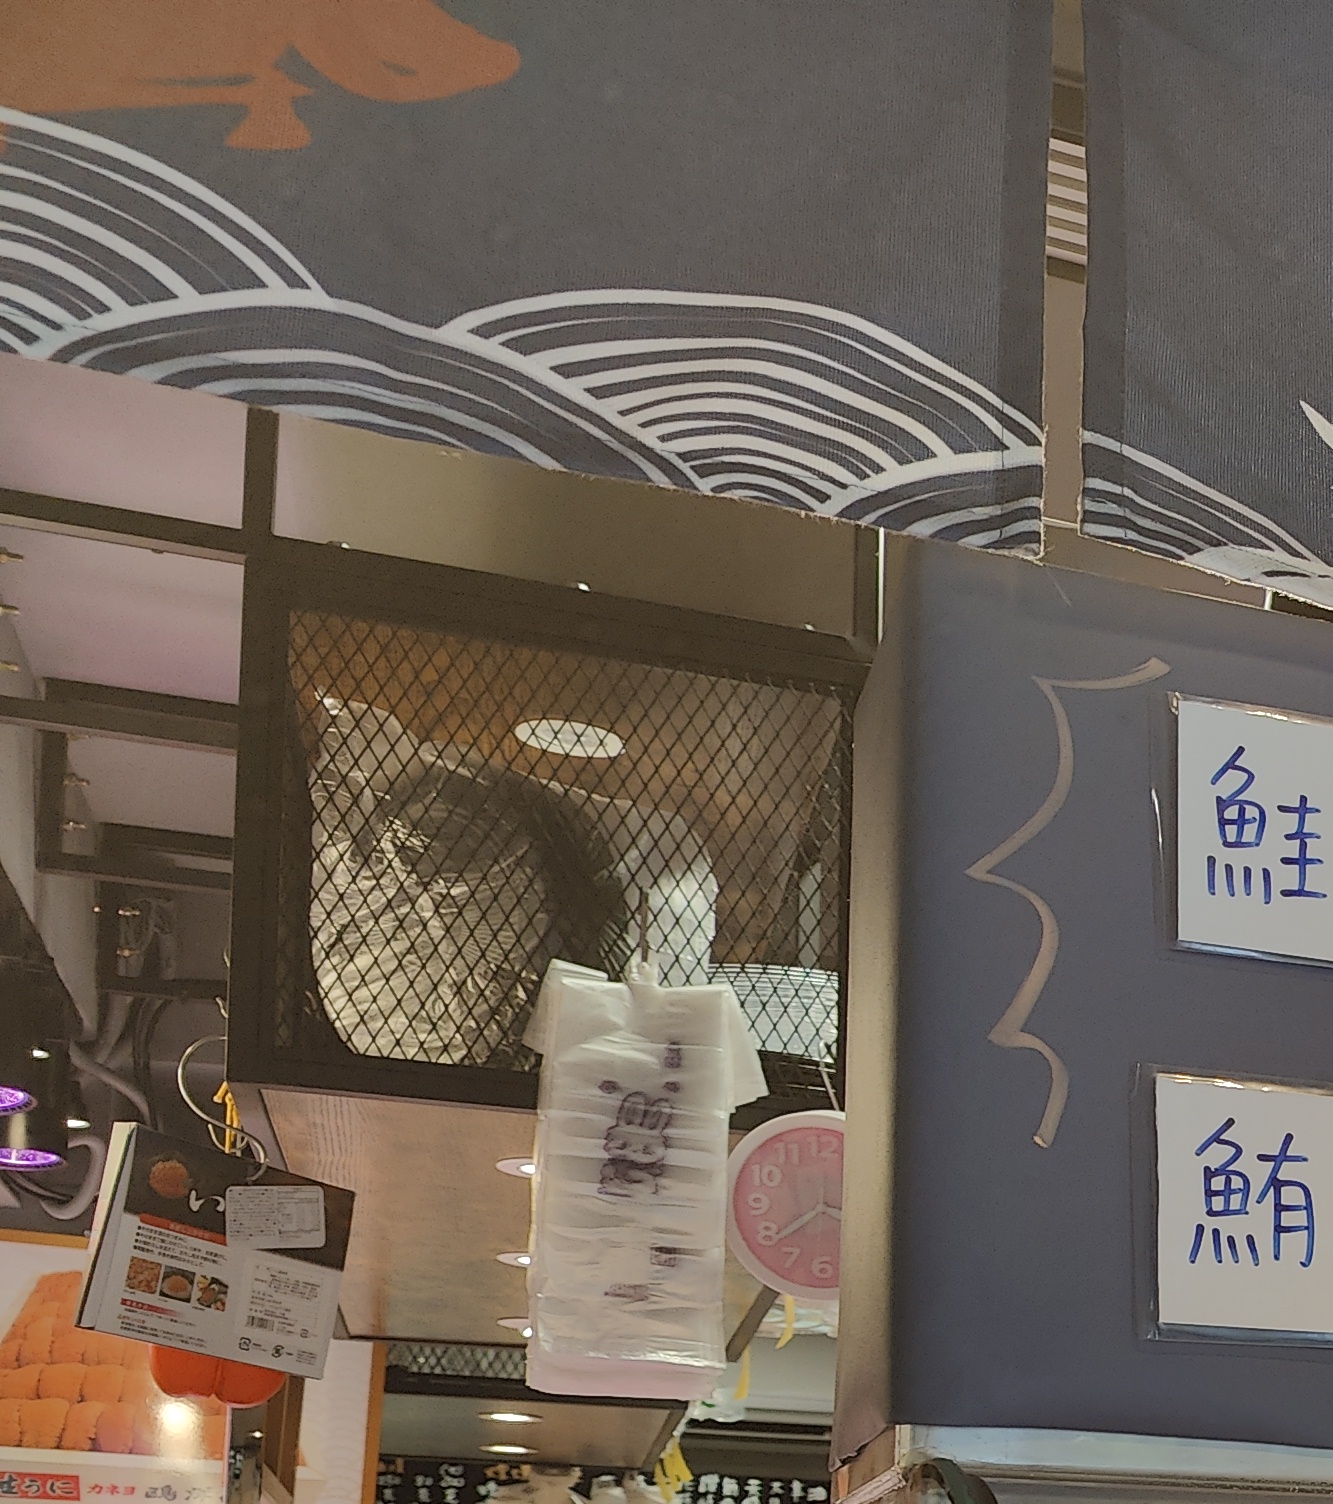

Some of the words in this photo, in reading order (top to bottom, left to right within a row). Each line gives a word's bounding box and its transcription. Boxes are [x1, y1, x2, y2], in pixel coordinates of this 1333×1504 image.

[774, 1142, 799, 1165] 11
[807, 1135, 838, 1159] 12
[751, 1164, 783, 1187] 10
[748, 1192, 770, 1216] 9
[756, 1221, 778, 1246] 8
[783, 1247, 800, 1268] 7
[811, 1255, 833, 1279] 6
